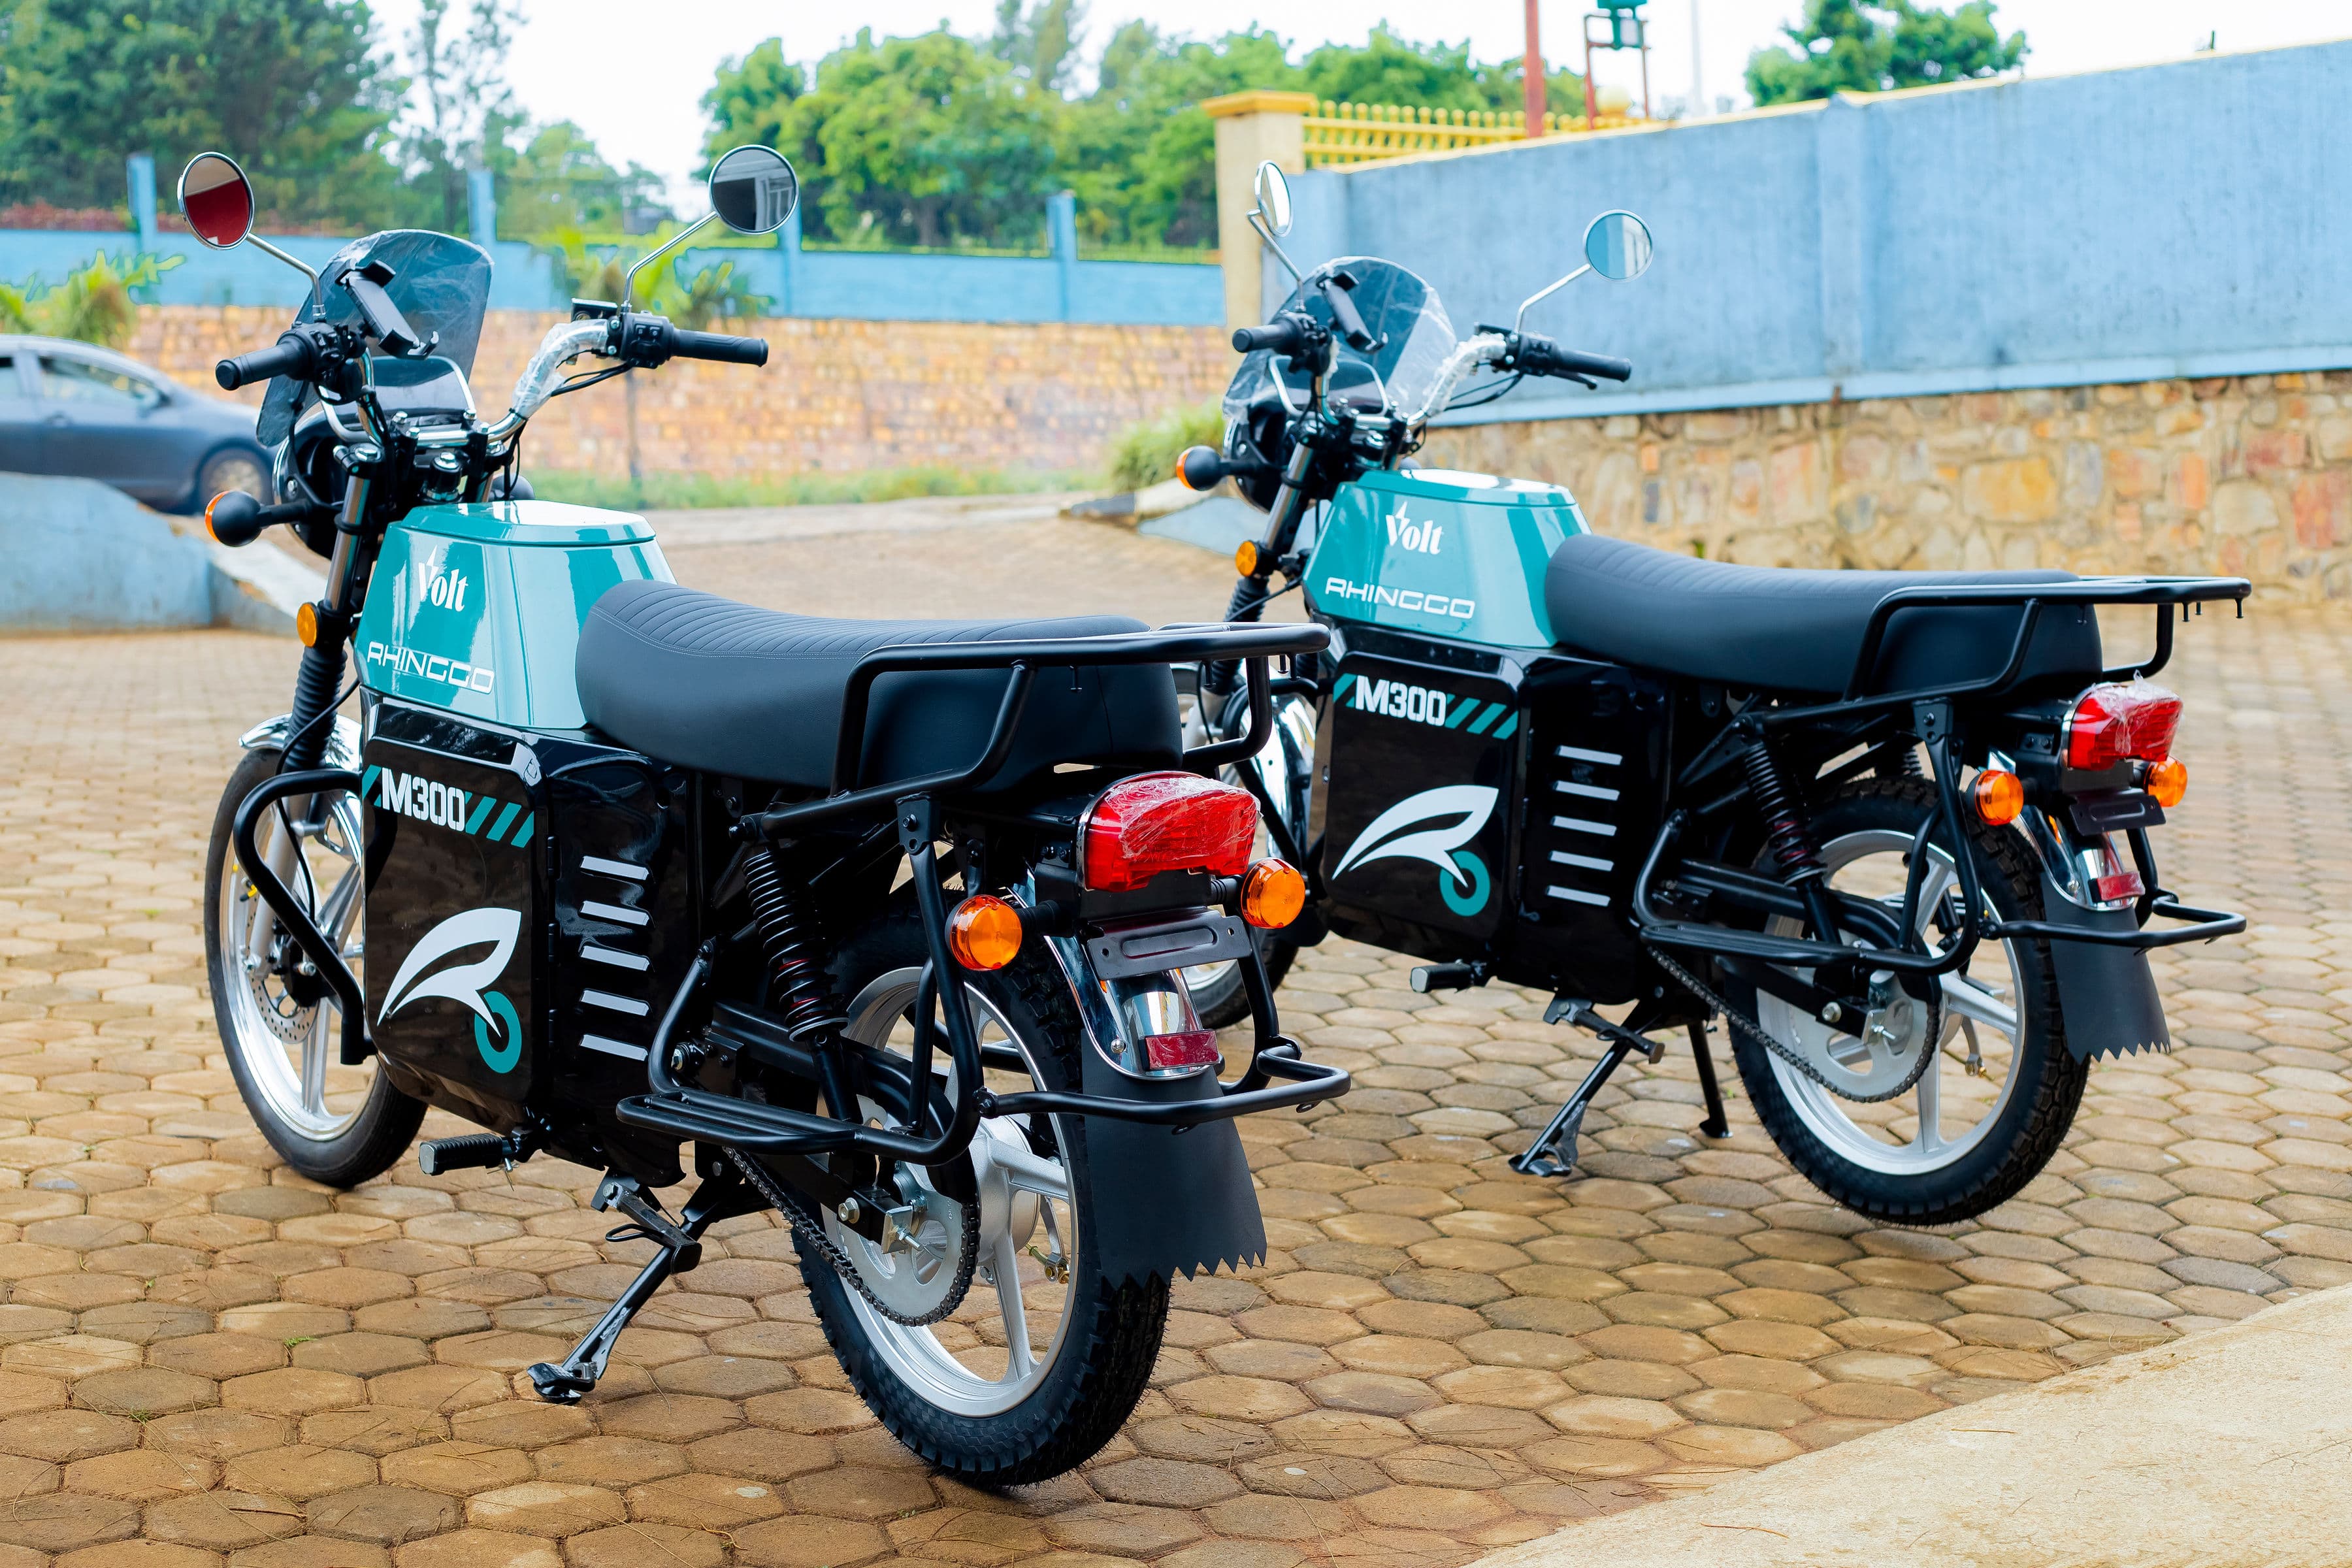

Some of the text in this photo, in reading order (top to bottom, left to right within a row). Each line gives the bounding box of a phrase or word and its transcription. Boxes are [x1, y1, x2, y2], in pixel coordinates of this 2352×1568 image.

[1386, 501, 1443, 555] Volt
[418, 545, 469, 612] Volt
[1355, 675, 1447, 727] M300
[381, 767, 466, 832] M300
